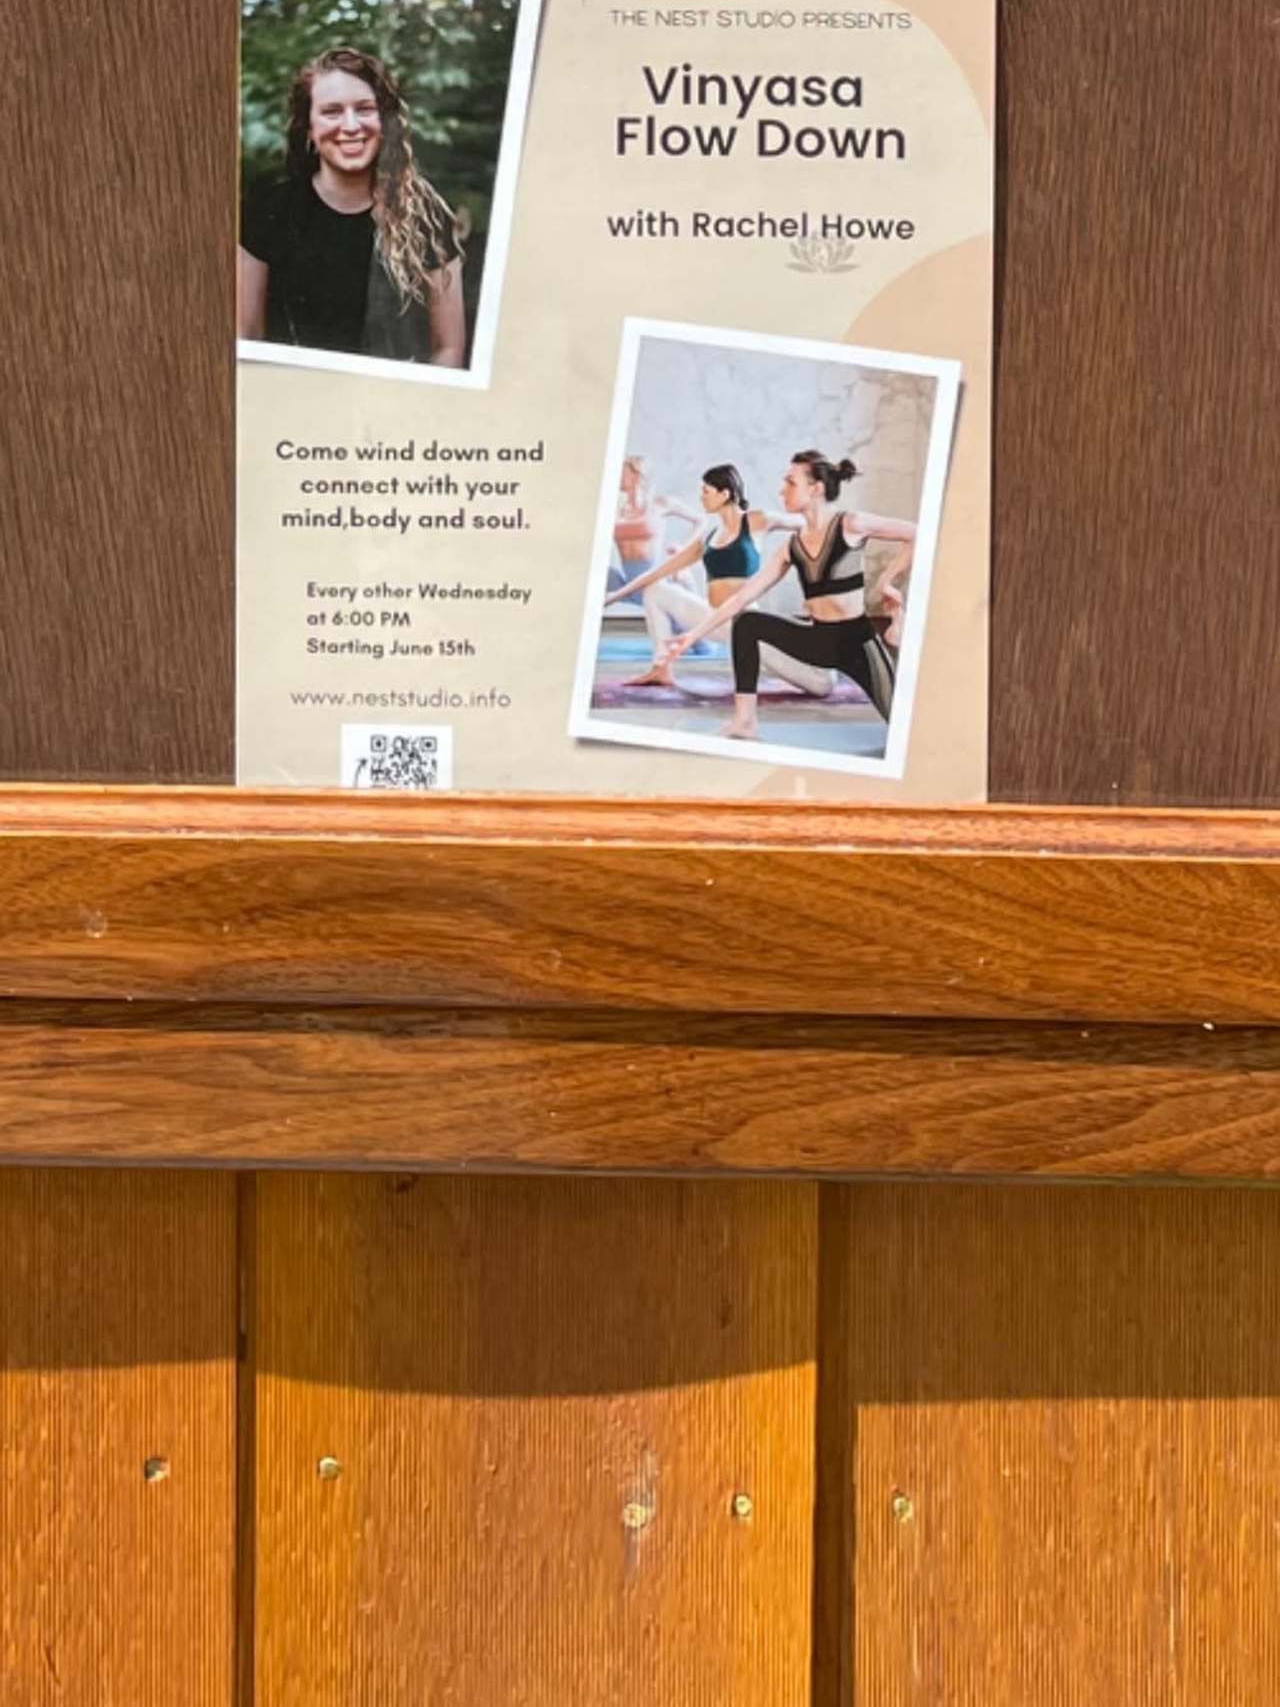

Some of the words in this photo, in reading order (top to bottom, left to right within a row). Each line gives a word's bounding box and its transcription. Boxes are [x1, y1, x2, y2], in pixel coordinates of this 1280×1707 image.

[611, 10, 647, 26] THE
[655, 10, 708, 27] NEST
[716, 11, 795, 28] STUDIO
[803, 12, 912, 30] PRESENTS
[643, 63, 863, 119] Vinyasa
[617, 117, 737, 157] Flow
[757, 118, 906, 159] Down
[607, 210, 679, 238] with
[692, 212, 808, 240] Rachel
[822, 215, 915, 240] Howe
[276, 441, 348, 461] Come
[355, 441, 415, 461] wind
[423, 441, 489, 461] down
[497, 441, 544, 462] and
[300, 476, 399, 495] connect
[406, 475, 458, 495] with
[465, 480, 520, 500] your
[282, 507, 411, 534] mind,body
[419, 508, 465, 529] and
[473, 509, 530, 529] soul.
[307, 582, 356, 602] Every
[363, 583, 412, 598] other
[419, 583, 532, 604] Wednesday
[307, 613, 326, 626] at
[333, 611, 375, 626] 6:00
[381, 613, 410, 627] PM
[307, 638, 384, 659] Starting
[390, 640, 433, 656] June
[439, 641, 475, 656] 15th
[290, 688, 512, 709] www.neststudio.info
